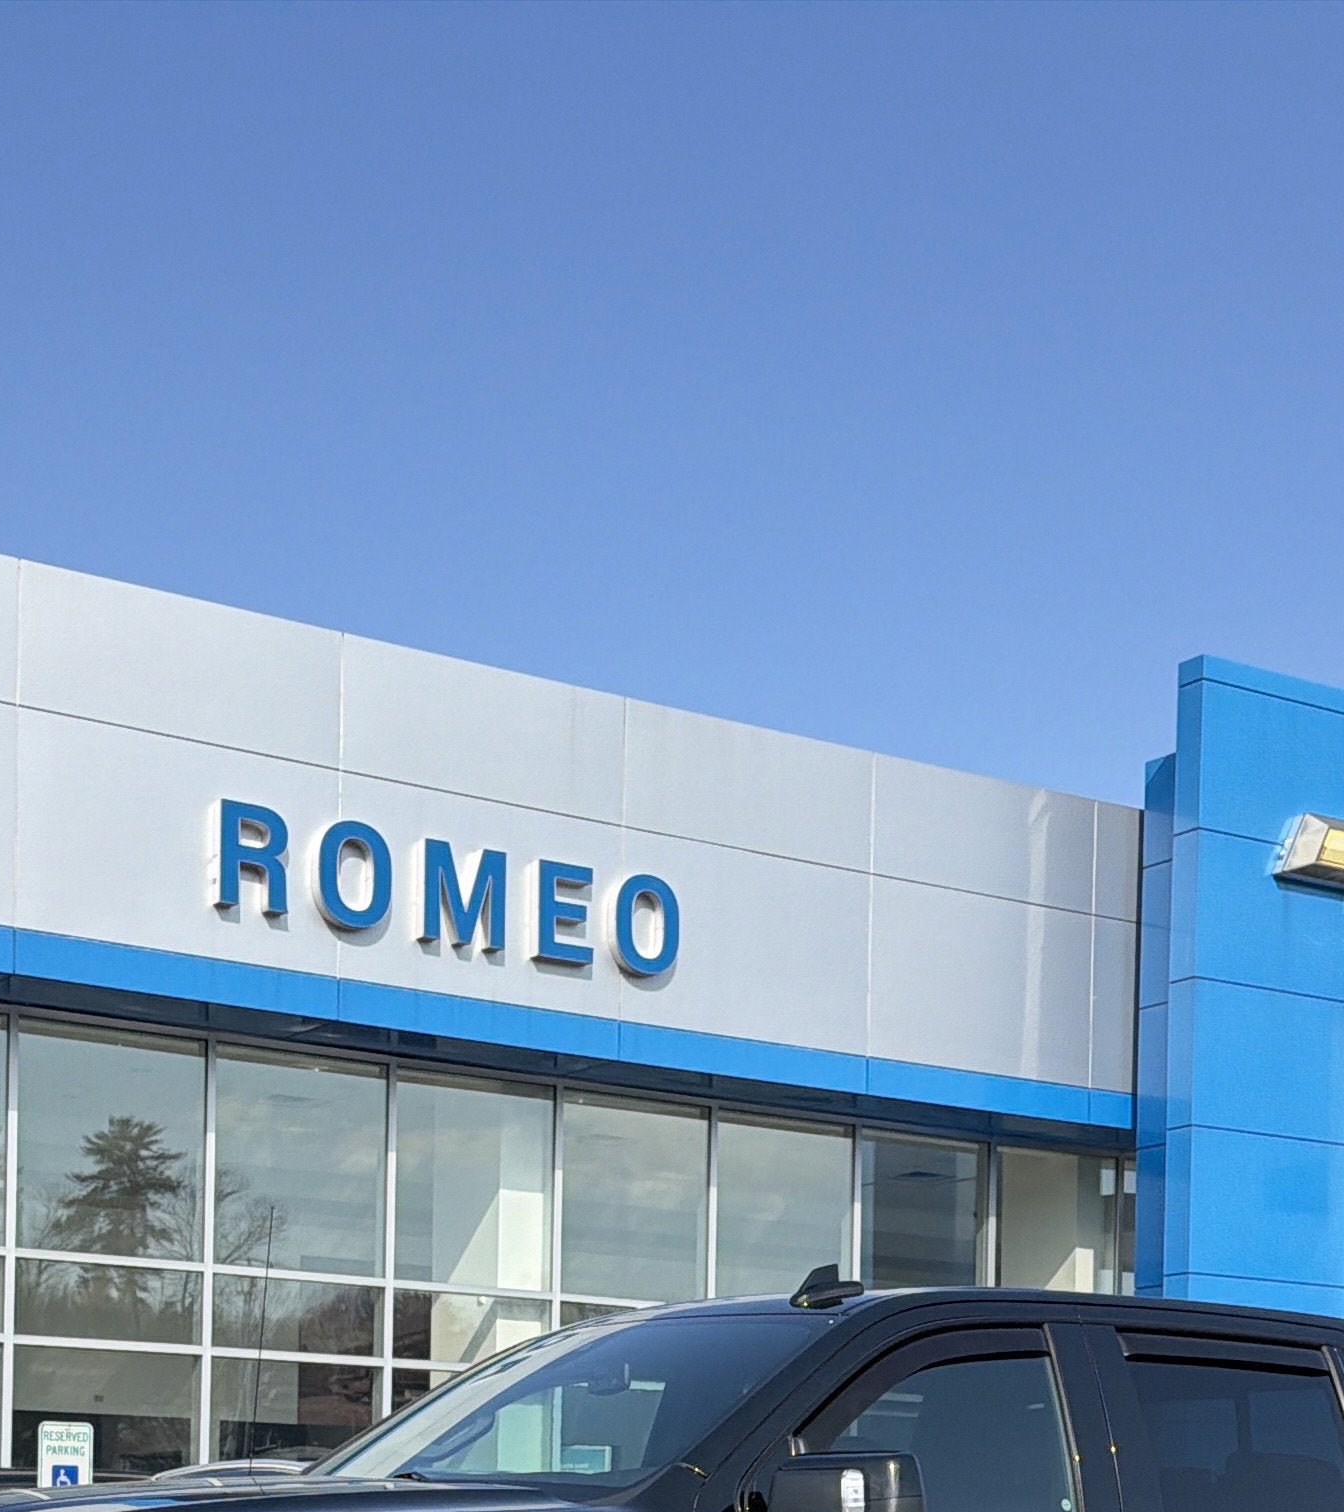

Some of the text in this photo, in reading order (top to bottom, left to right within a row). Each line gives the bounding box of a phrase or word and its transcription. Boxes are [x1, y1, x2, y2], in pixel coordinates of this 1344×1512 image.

[214, 798, 680, 976] ROMEO
[43, 1431, 89, 1442] RESERVED
[46, 1445, 86, 1456] PARKING
